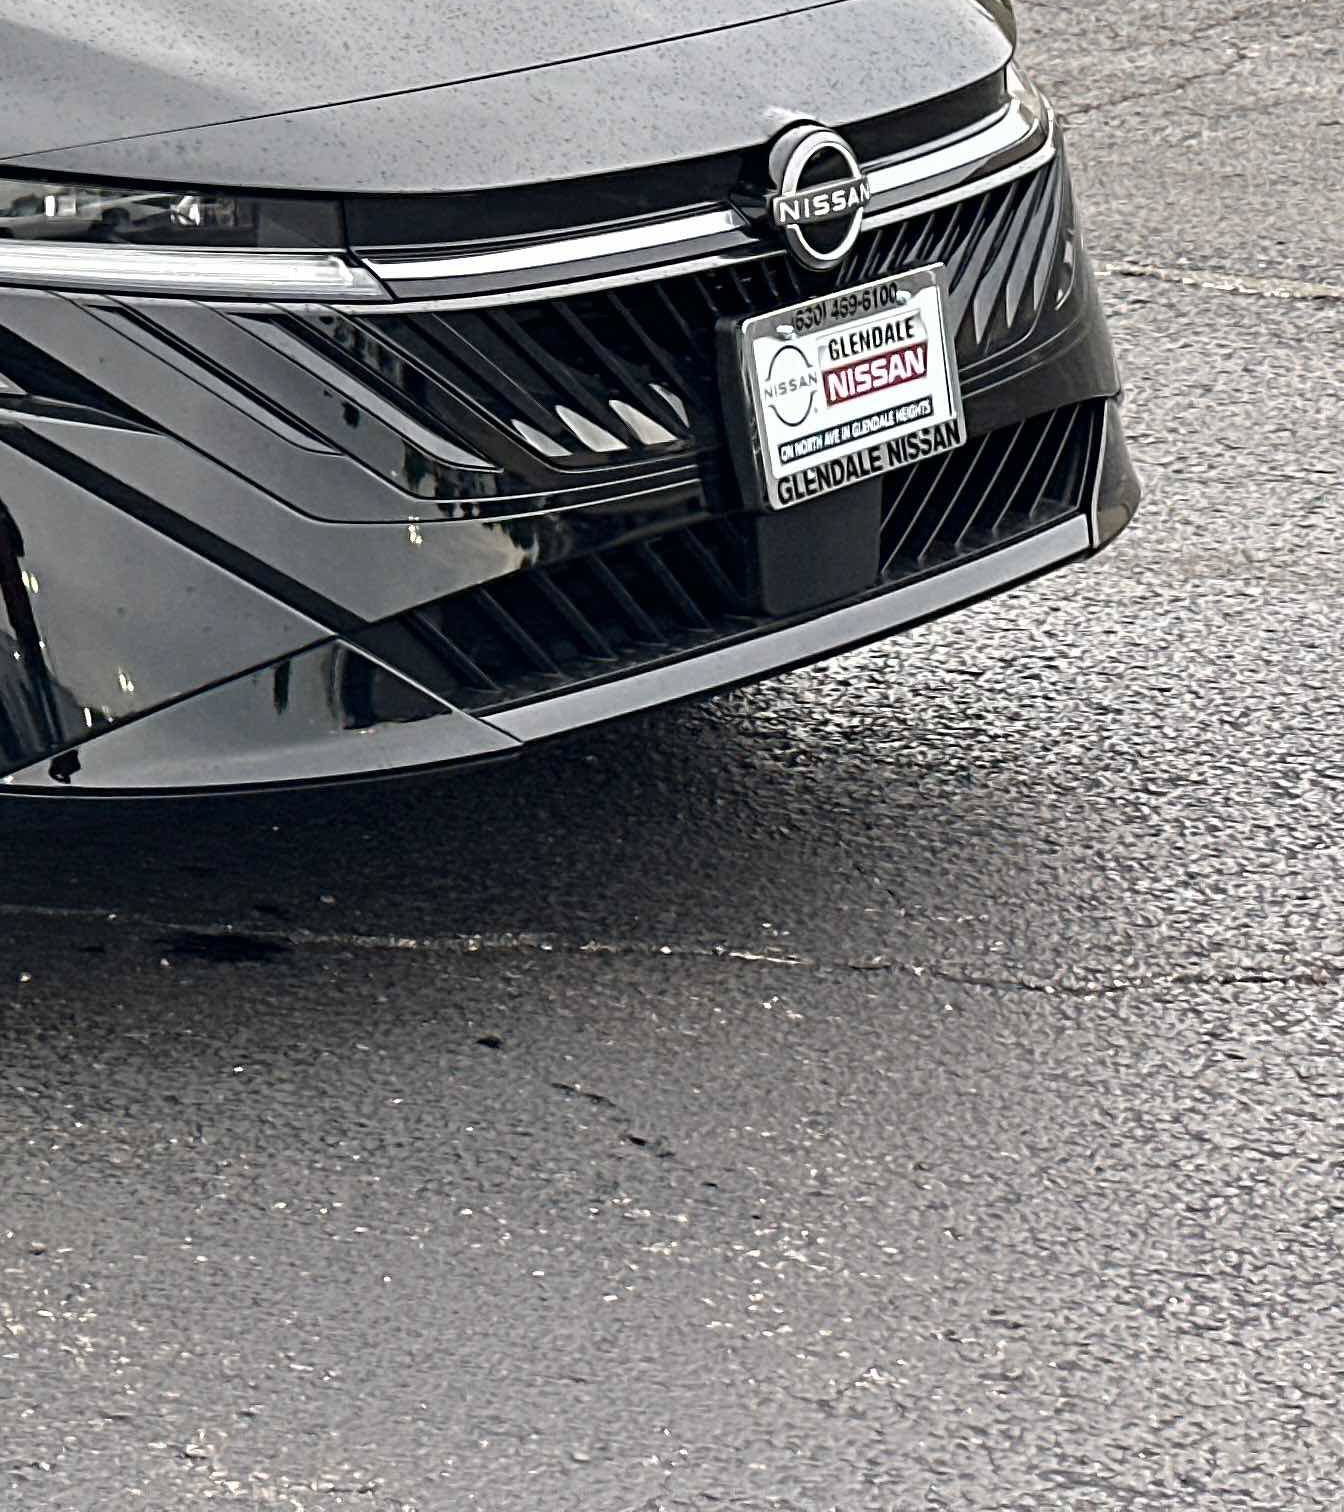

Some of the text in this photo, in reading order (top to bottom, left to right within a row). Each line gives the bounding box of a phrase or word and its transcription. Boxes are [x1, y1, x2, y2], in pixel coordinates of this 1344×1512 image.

[779, 182, 871, 223] NISSAN
[830, 282, 898, 320] 469-6100
[828, 317, 914, 361] GLENDALE
[764, 370, 818, 401] NISSAN
[826, 348, 927, 401] NISSAN
[851, 409, 895, 438] GLENDALE
[777, 419, 961, 506] GLENDALE NISSAN
